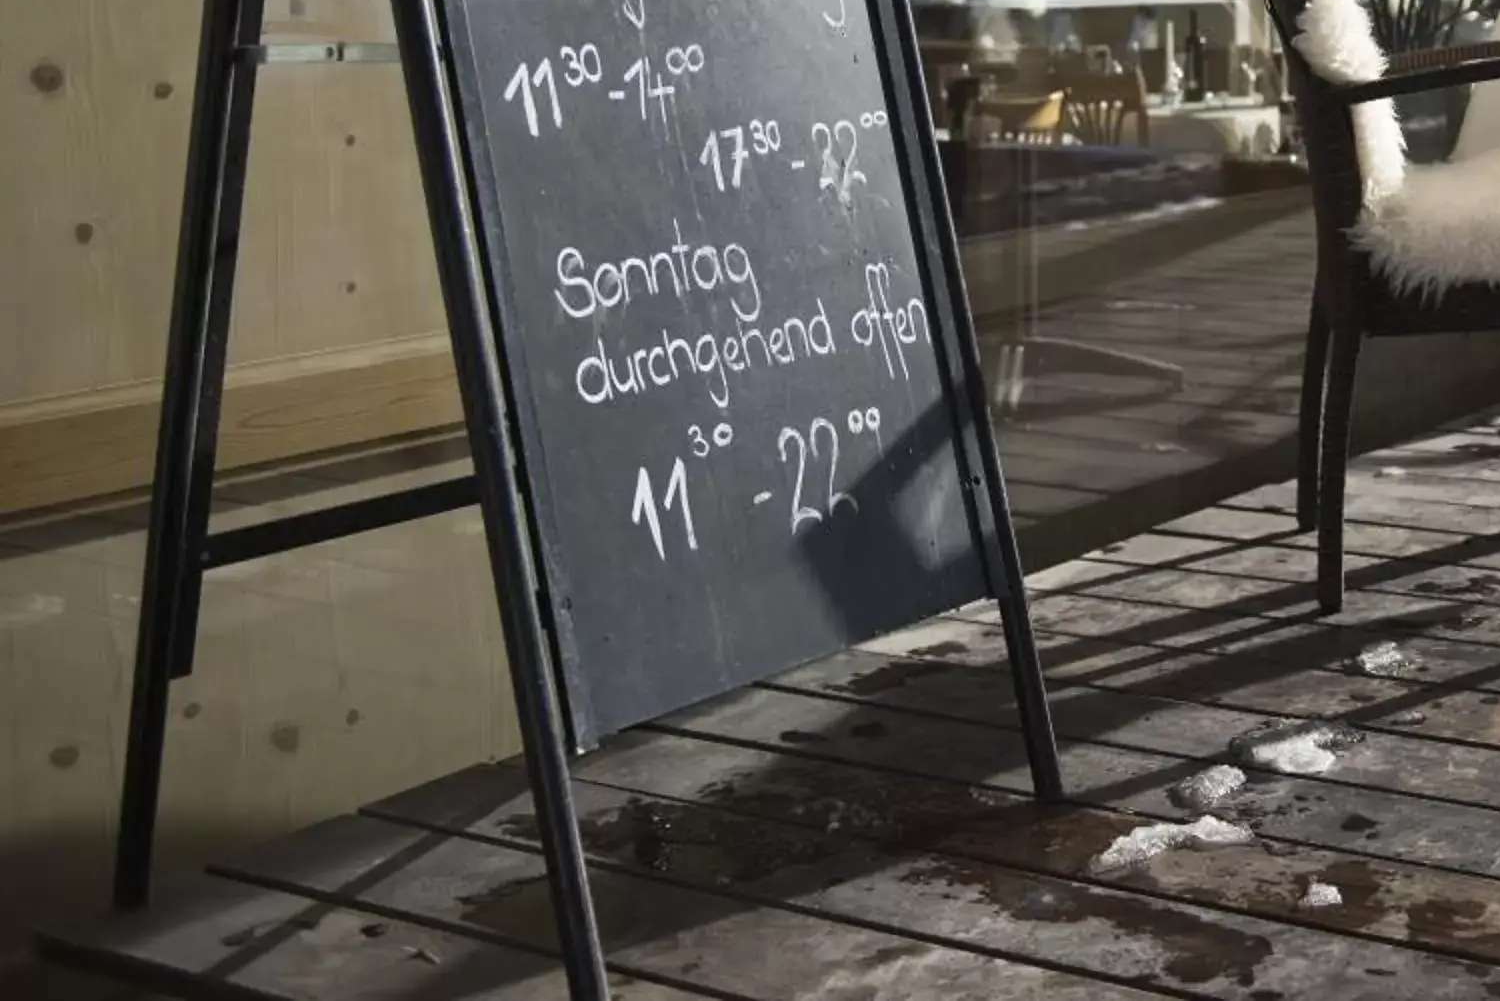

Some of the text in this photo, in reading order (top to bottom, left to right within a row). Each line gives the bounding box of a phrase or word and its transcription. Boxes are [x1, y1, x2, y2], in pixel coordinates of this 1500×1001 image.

[555, 216, 762, 323] Sonntag
[575, 261, 931, 409] durchgehend offen
